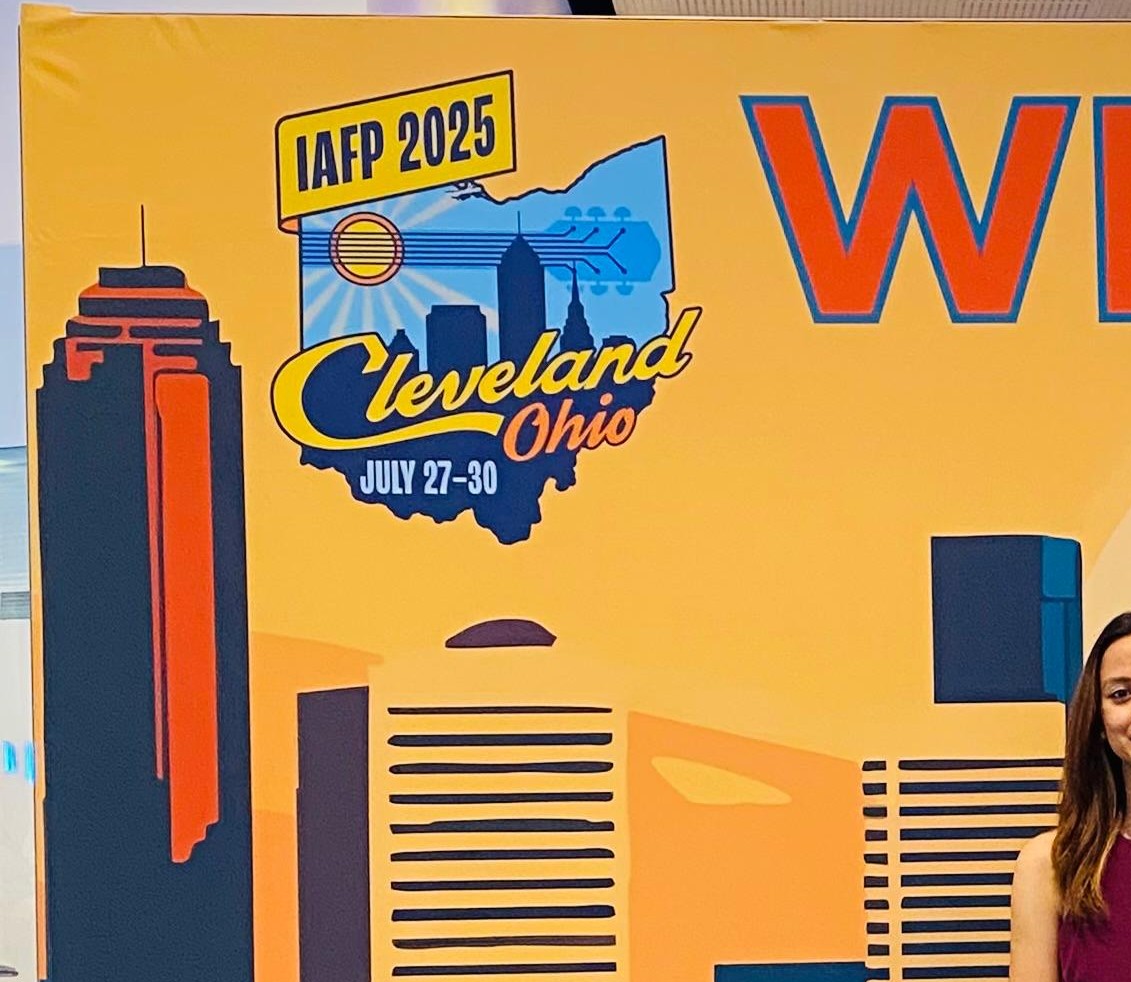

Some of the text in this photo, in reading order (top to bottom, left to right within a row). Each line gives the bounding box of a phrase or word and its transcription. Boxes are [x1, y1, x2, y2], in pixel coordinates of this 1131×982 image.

[296, 94, 496, 192] IAFP 2025
[271, 306, 702, 451] Cleveland
[502, 393, 637, 463] Ohio
[360, 460, 415, 495] JULY
